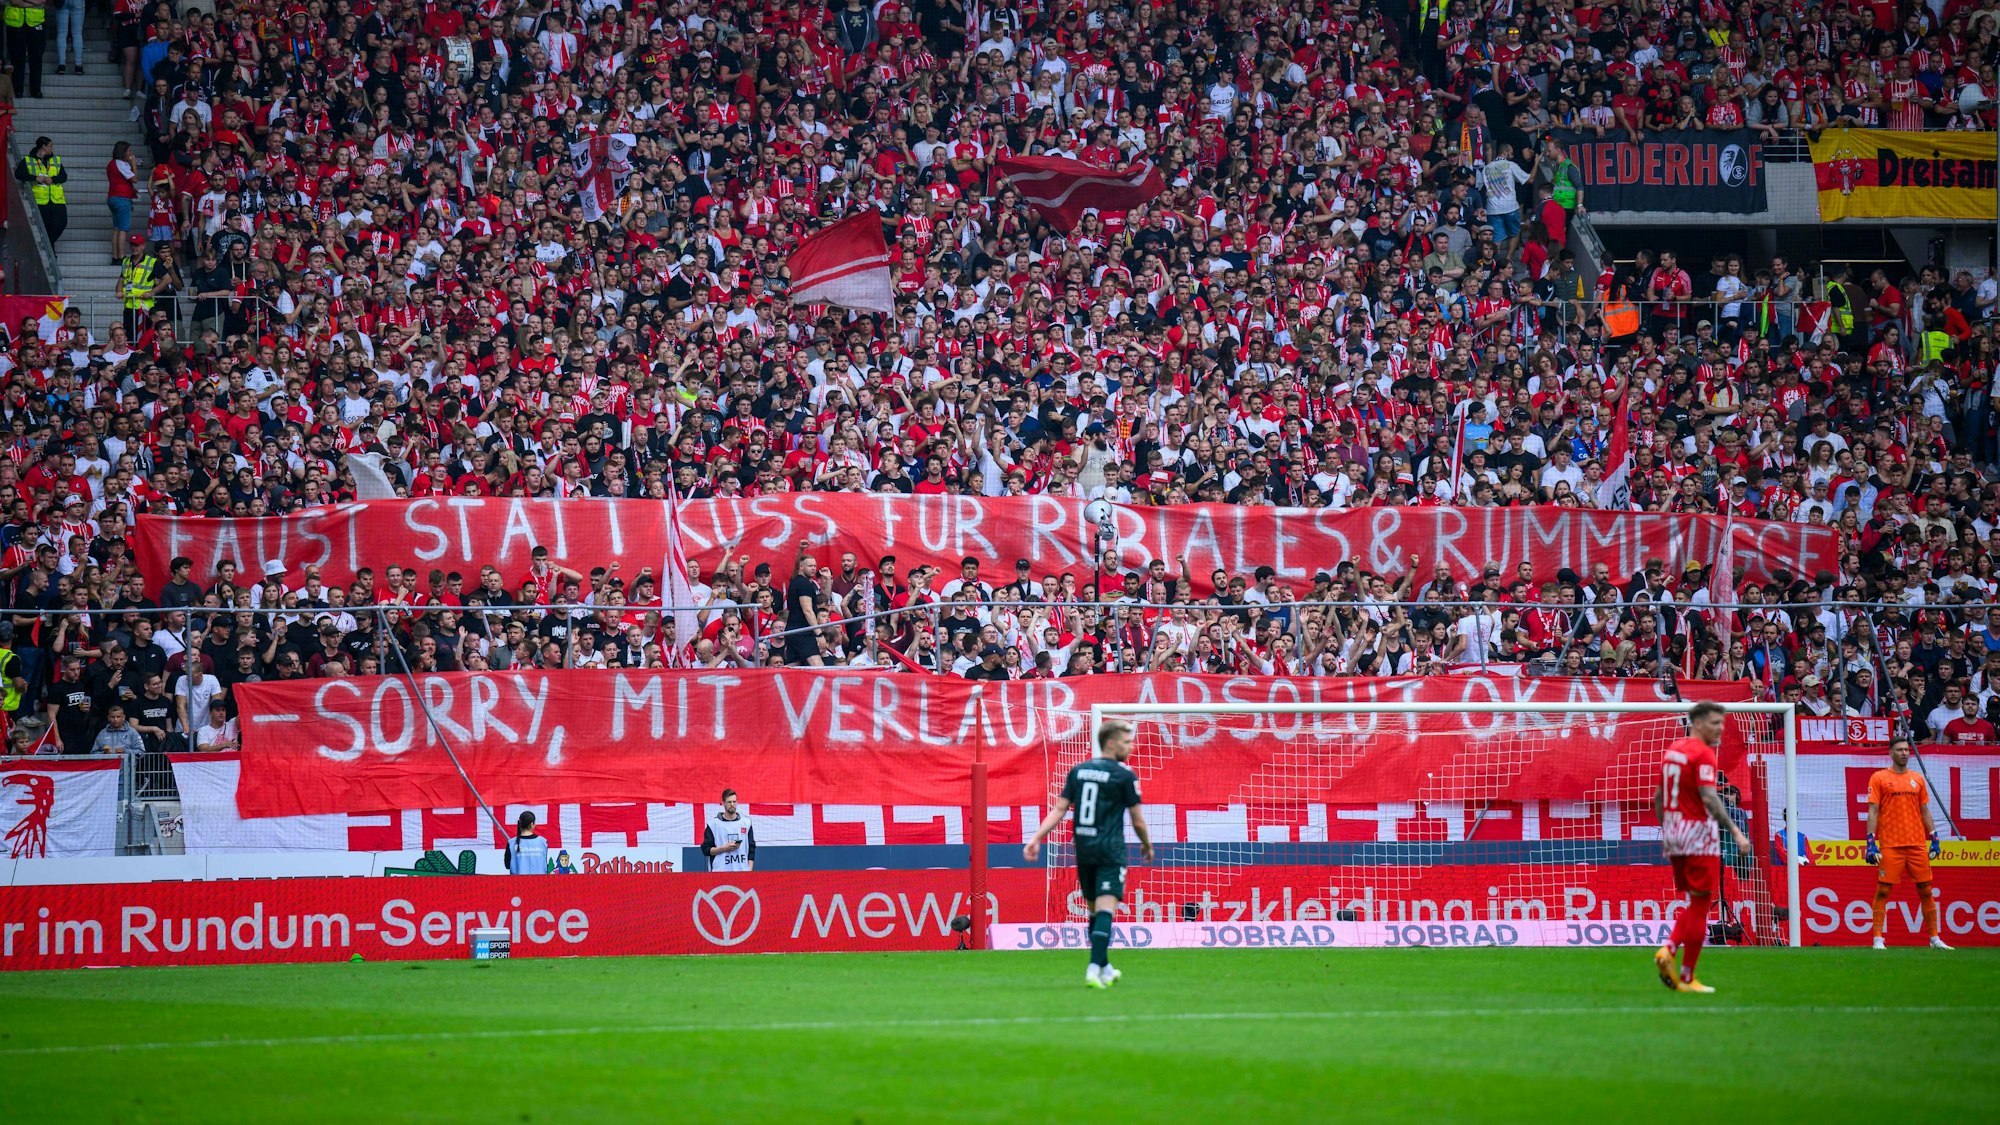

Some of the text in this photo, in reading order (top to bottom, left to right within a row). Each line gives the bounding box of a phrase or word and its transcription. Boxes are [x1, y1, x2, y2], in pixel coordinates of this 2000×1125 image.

[167, 503, 371, 577] FAUST
[662, 495, 836, 548] KUSS
[1370, 507, 1402, 574] &
[315, 674, 565, 766] SORRY,
[611, 673, 741, 741] MIT
[774, 673, 1083, 747] VERLAUB
[1131, 677, 1424, 746] ABSOLUT
[1460, 676, 1626, 741] OKAY
[1662, 763, 1681, 808] 17
[1079, 782, 1099, 826] 8
[725, 855, 746, 865] SMF
[1836, 845, 2000, 860] LOT tto-bw.de
[1486, 886, 1547, 920] im
[38, 907, 103, 955] im
[121, 896, 590, 953] Rundum-Service
[1200, 925, 1335, 947] JOBRAD
[1384, 924, 1518, 946] JOBRAD
[1567, 924, 1672, 945] JOBRA
[490, 942, 510, 950] SPORT
